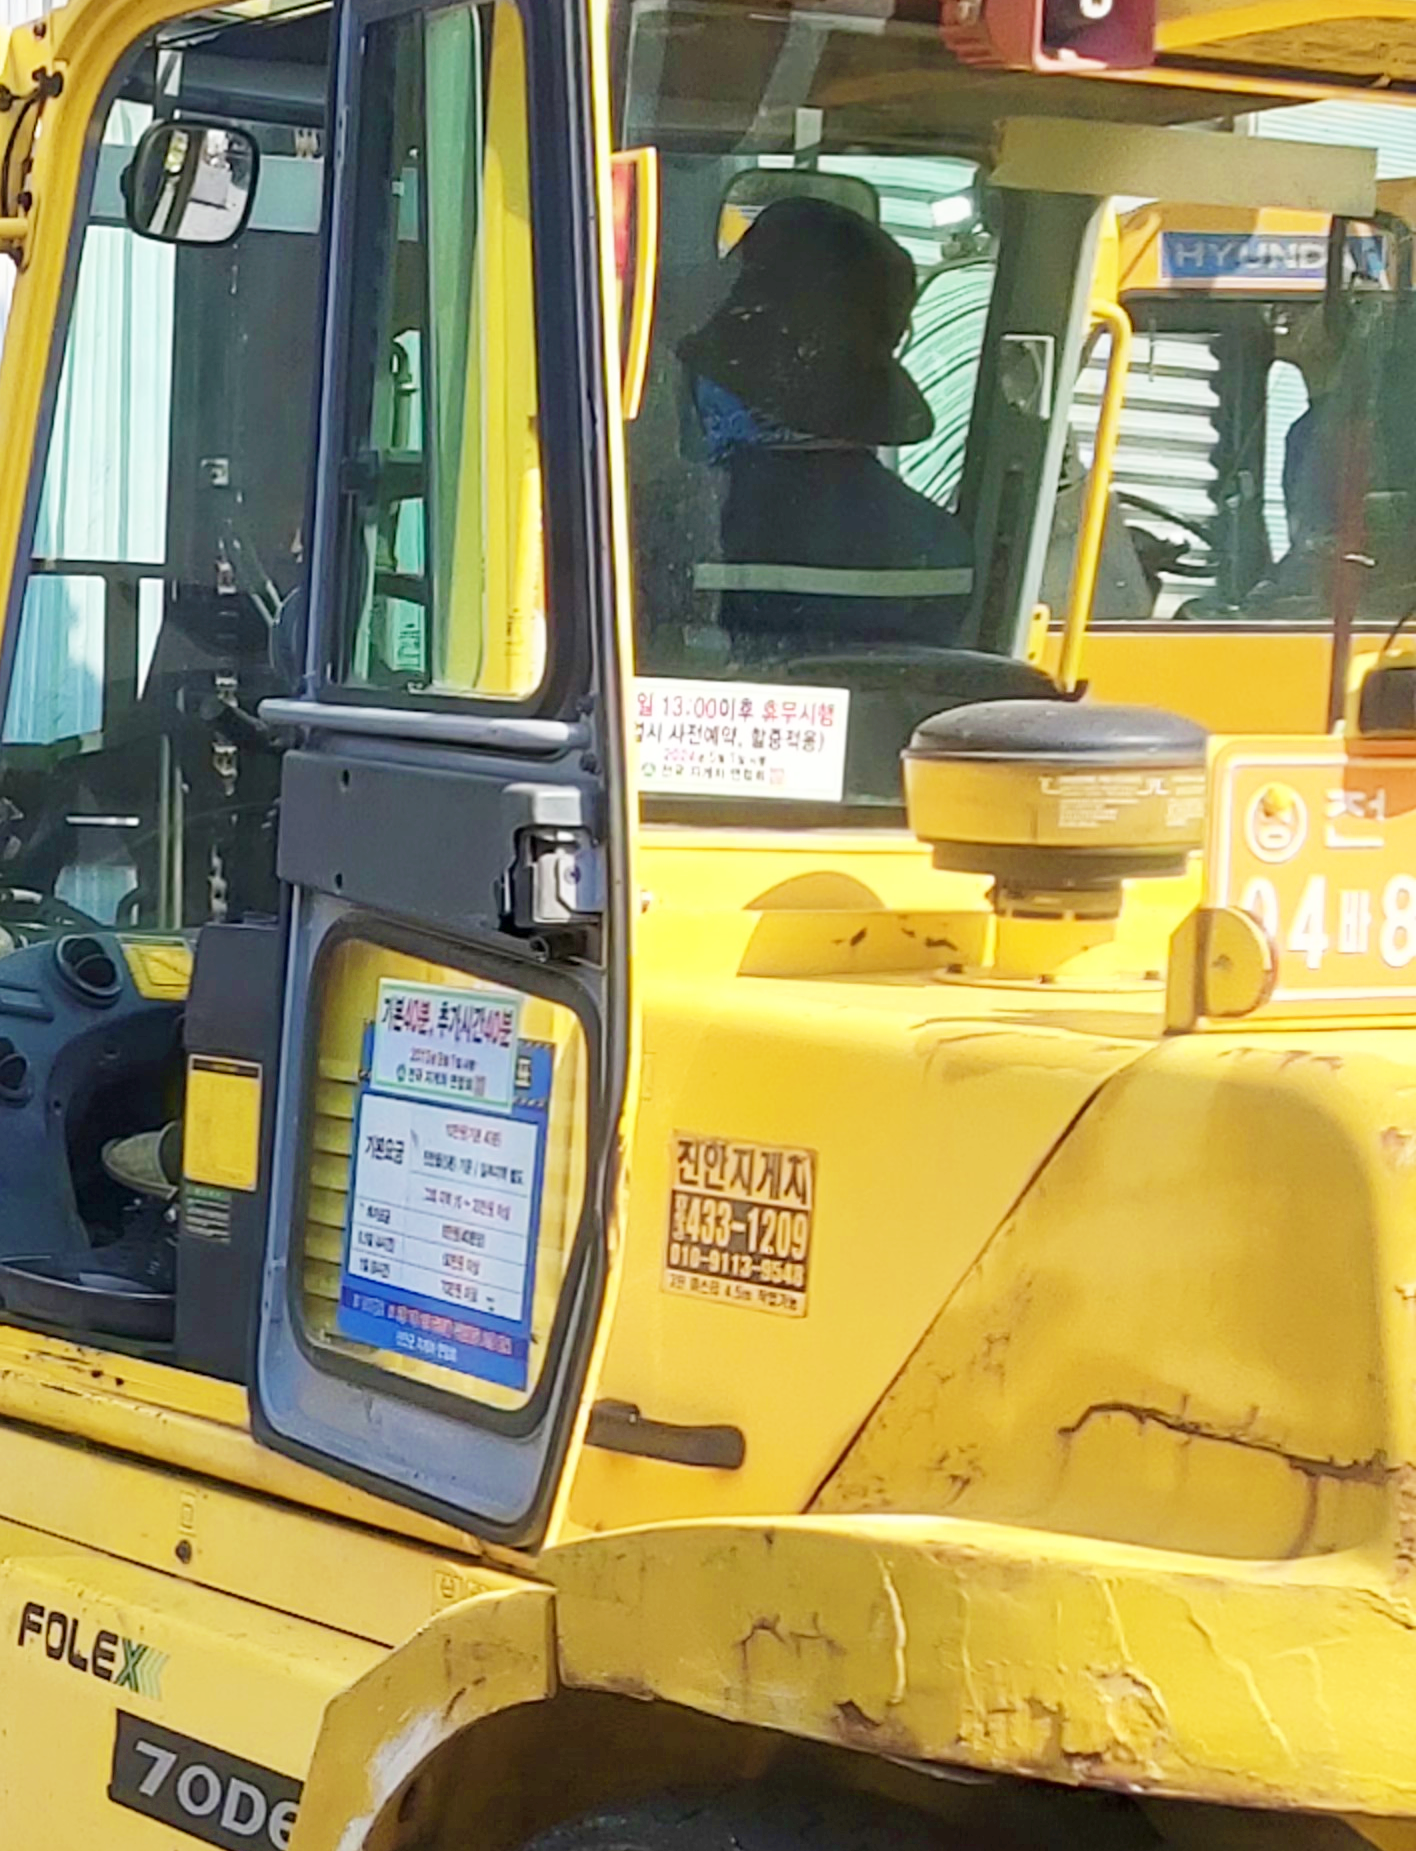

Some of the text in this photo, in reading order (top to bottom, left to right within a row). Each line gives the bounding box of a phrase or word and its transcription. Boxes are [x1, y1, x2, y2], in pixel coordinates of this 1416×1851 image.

[663, 695, 754, 725] 13:00이후
[762, 700, 835, 727] 휴무시행
[686, 1196, 808, 1261] 433-1209
[18, 1601, 150, 1693] FOLEX
